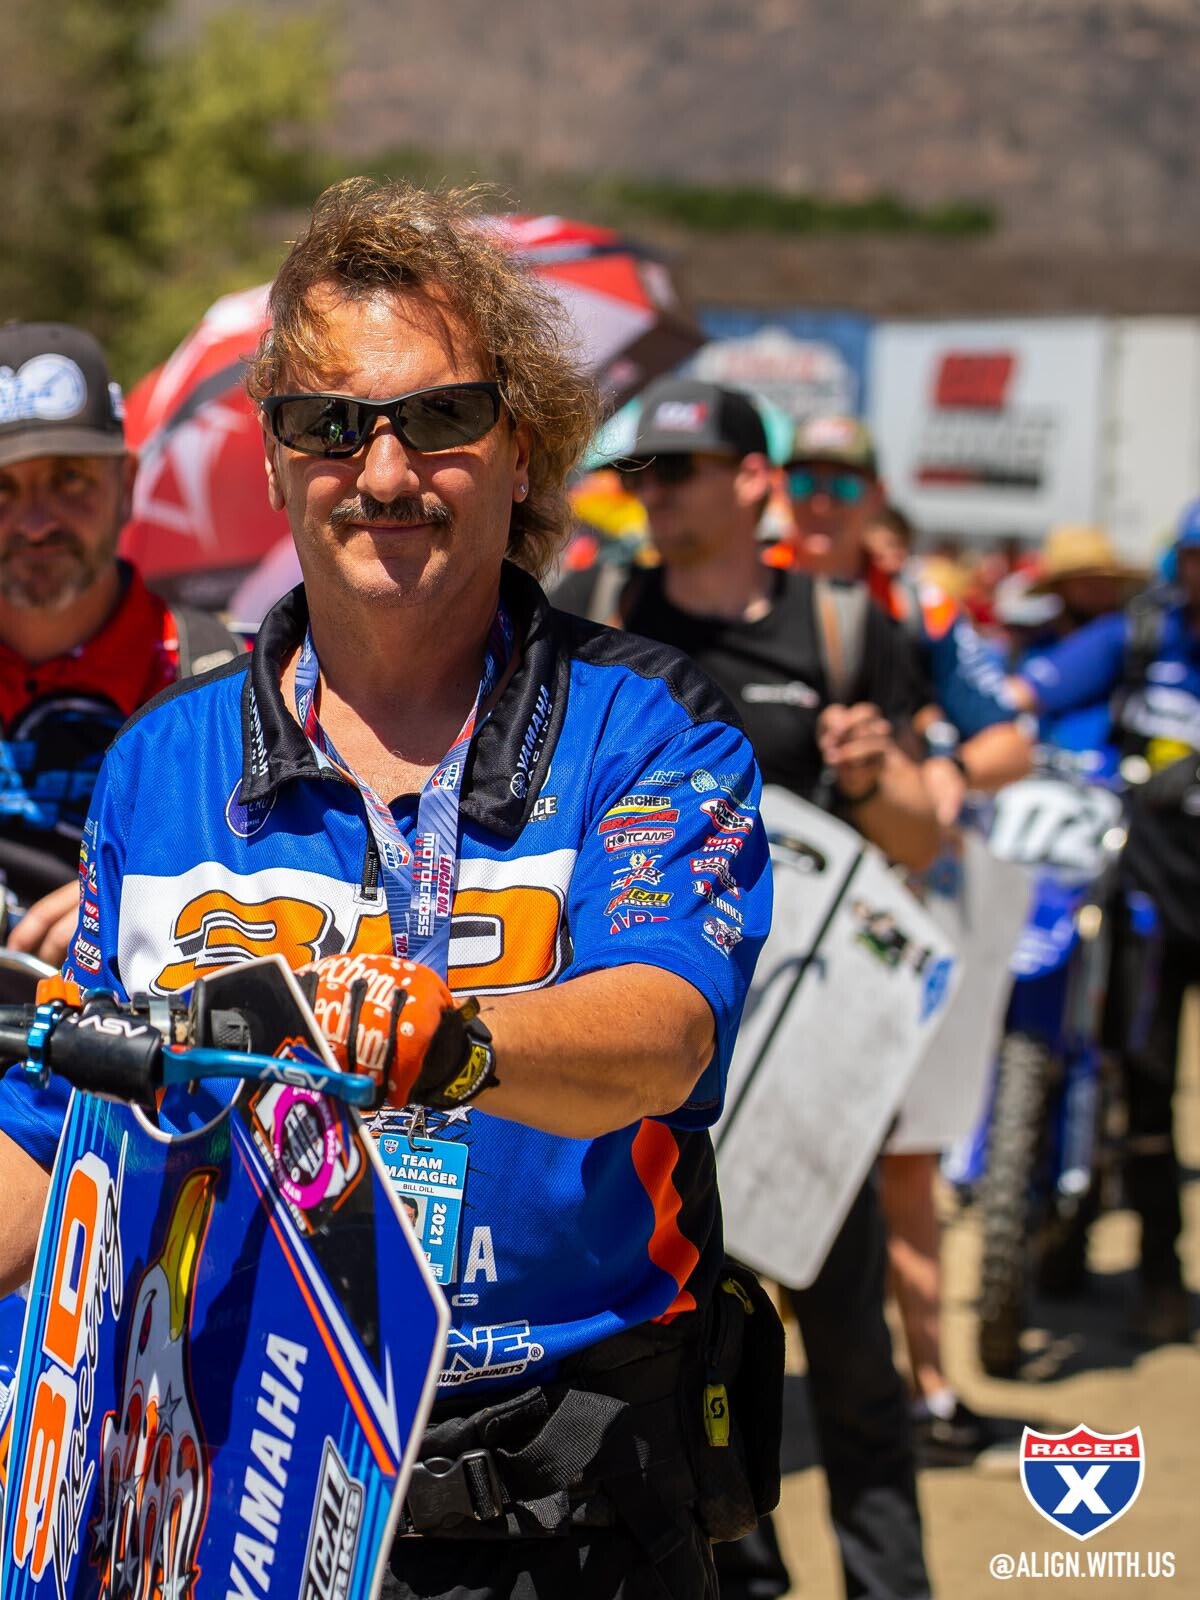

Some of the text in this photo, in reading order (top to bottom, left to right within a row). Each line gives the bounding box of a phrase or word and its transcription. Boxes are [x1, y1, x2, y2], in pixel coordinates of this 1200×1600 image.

[517, 684, 550, 771] YAMAHA
[600, 810, 678, 834] BRAKING
[607, 831, 673, 848] HOTCAMS
[418, 832, 435, 936] MOTOCROSS
[436, 856, 452, 916] LUCAS OIL
[78, 1014, 148, 1038] ASV
[259, 1064, 329, 1090] ASV
[401, 1154, 443, 1170] TEAM
[384, 1165, 458, 1186] MANAGER
[403, 1183, 434, 1194] BILL DILL
[429, 1202, 447, 1246] 2021
[14, 1167, 98, 1577] 3D
[464, 1364, 524, 1381] CABINETS
[225, 1333, 308, 1600] YAMAHA
